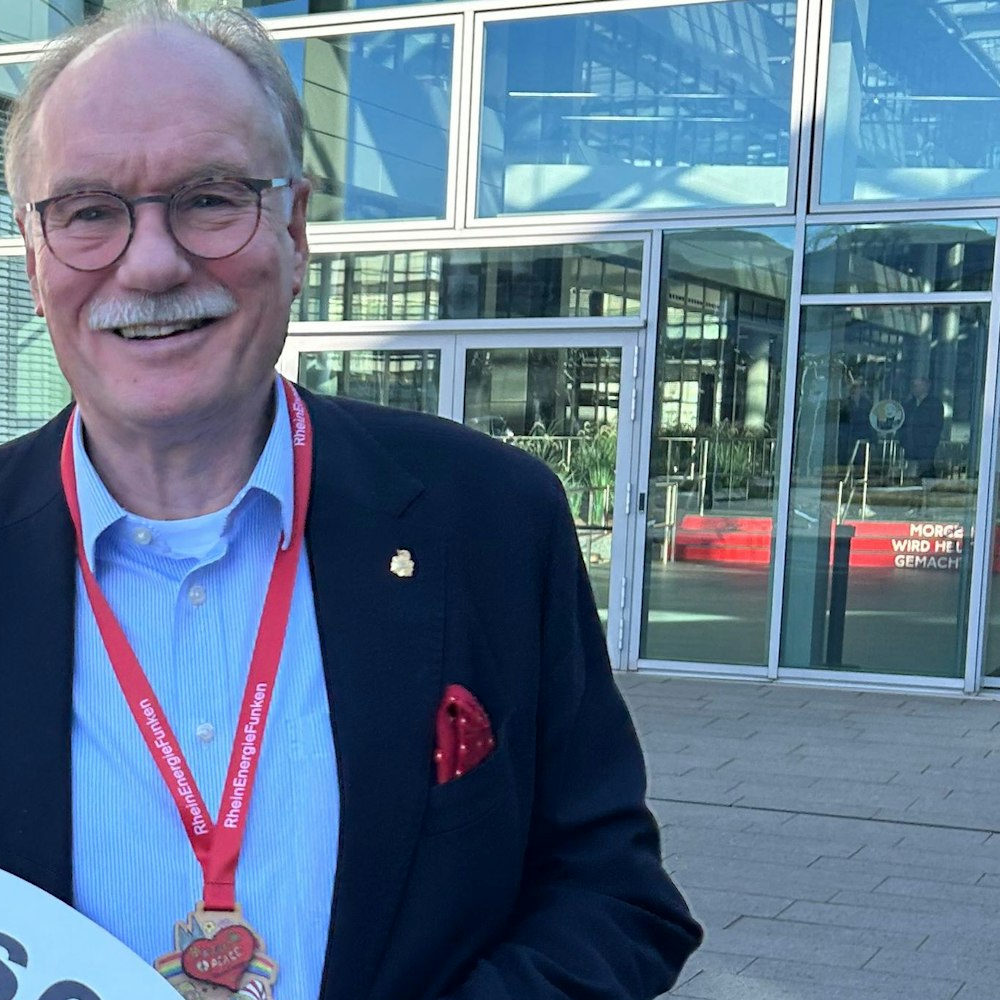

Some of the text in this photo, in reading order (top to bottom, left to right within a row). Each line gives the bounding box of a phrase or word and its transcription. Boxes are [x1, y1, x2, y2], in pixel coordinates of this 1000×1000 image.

[891, 539, 931, 553] WIRD
[894, 555, 963, 569] GEMACH
[139, 697, 209, 835] RheinEnergieFunken
[224, 682, 267, 829] RheinEnergieFunken
